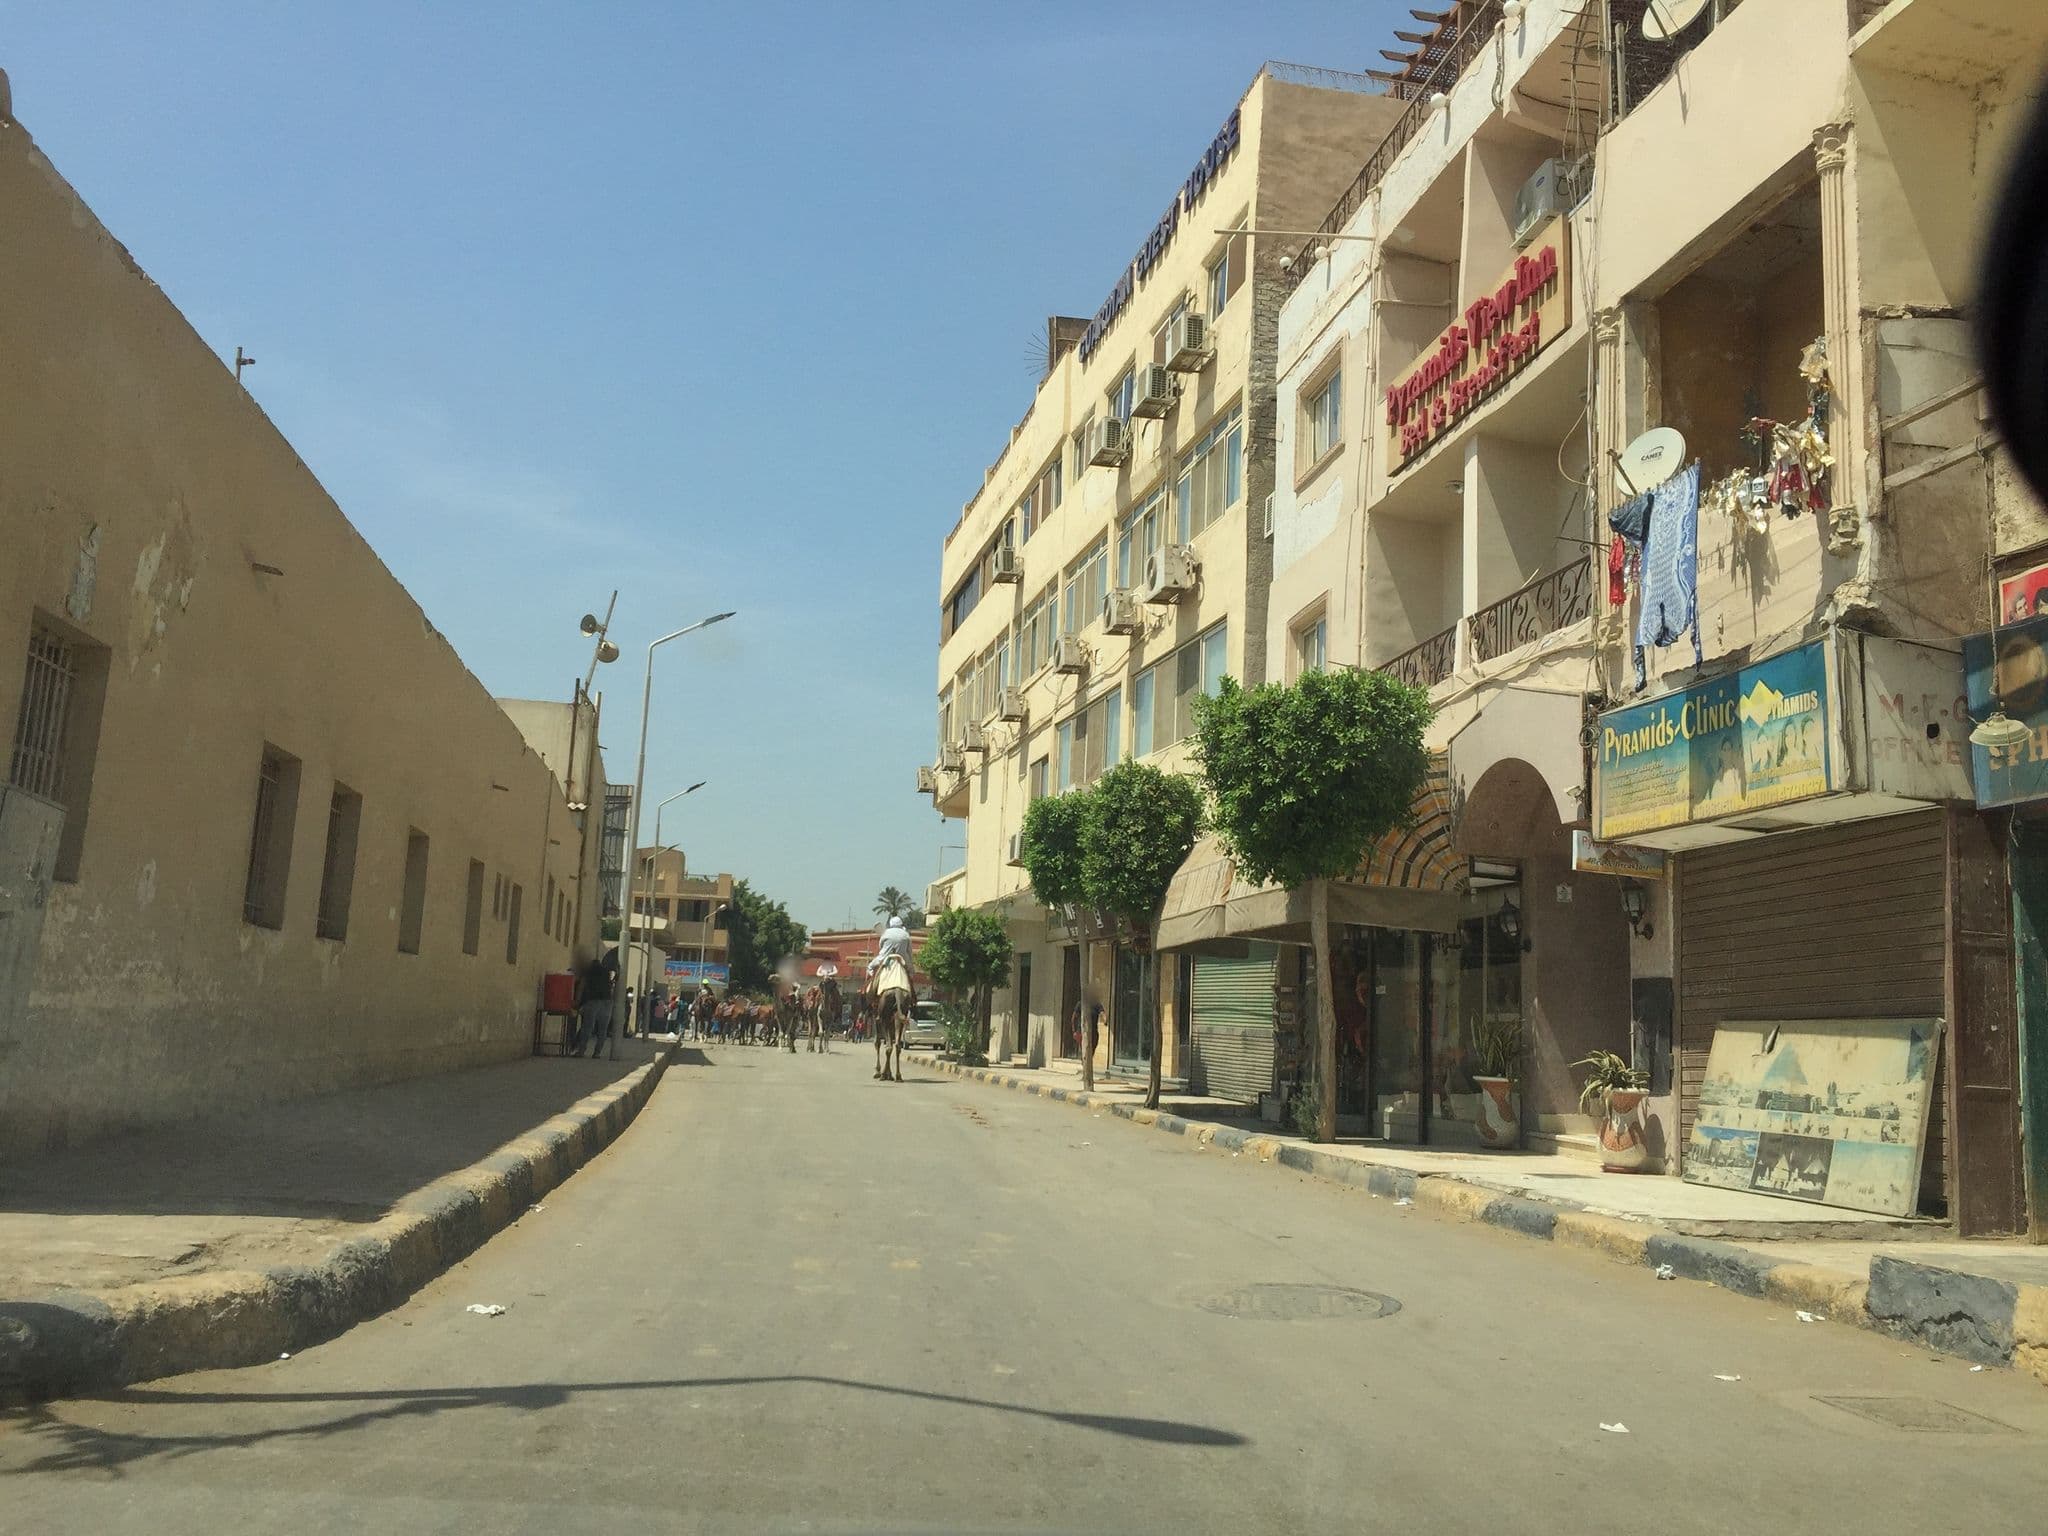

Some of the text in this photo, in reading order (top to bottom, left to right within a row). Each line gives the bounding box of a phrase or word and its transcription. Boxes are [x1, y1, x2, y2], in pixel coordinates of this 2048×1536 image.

[1079, 108, 1241, 363] GUARDIAN GUEST HOUSE
[1386, 245, 1558, 426] Pyramids View Inn
[1400, 407, 1428, 456] Bed
[1432, 395, 1446, 428] &
